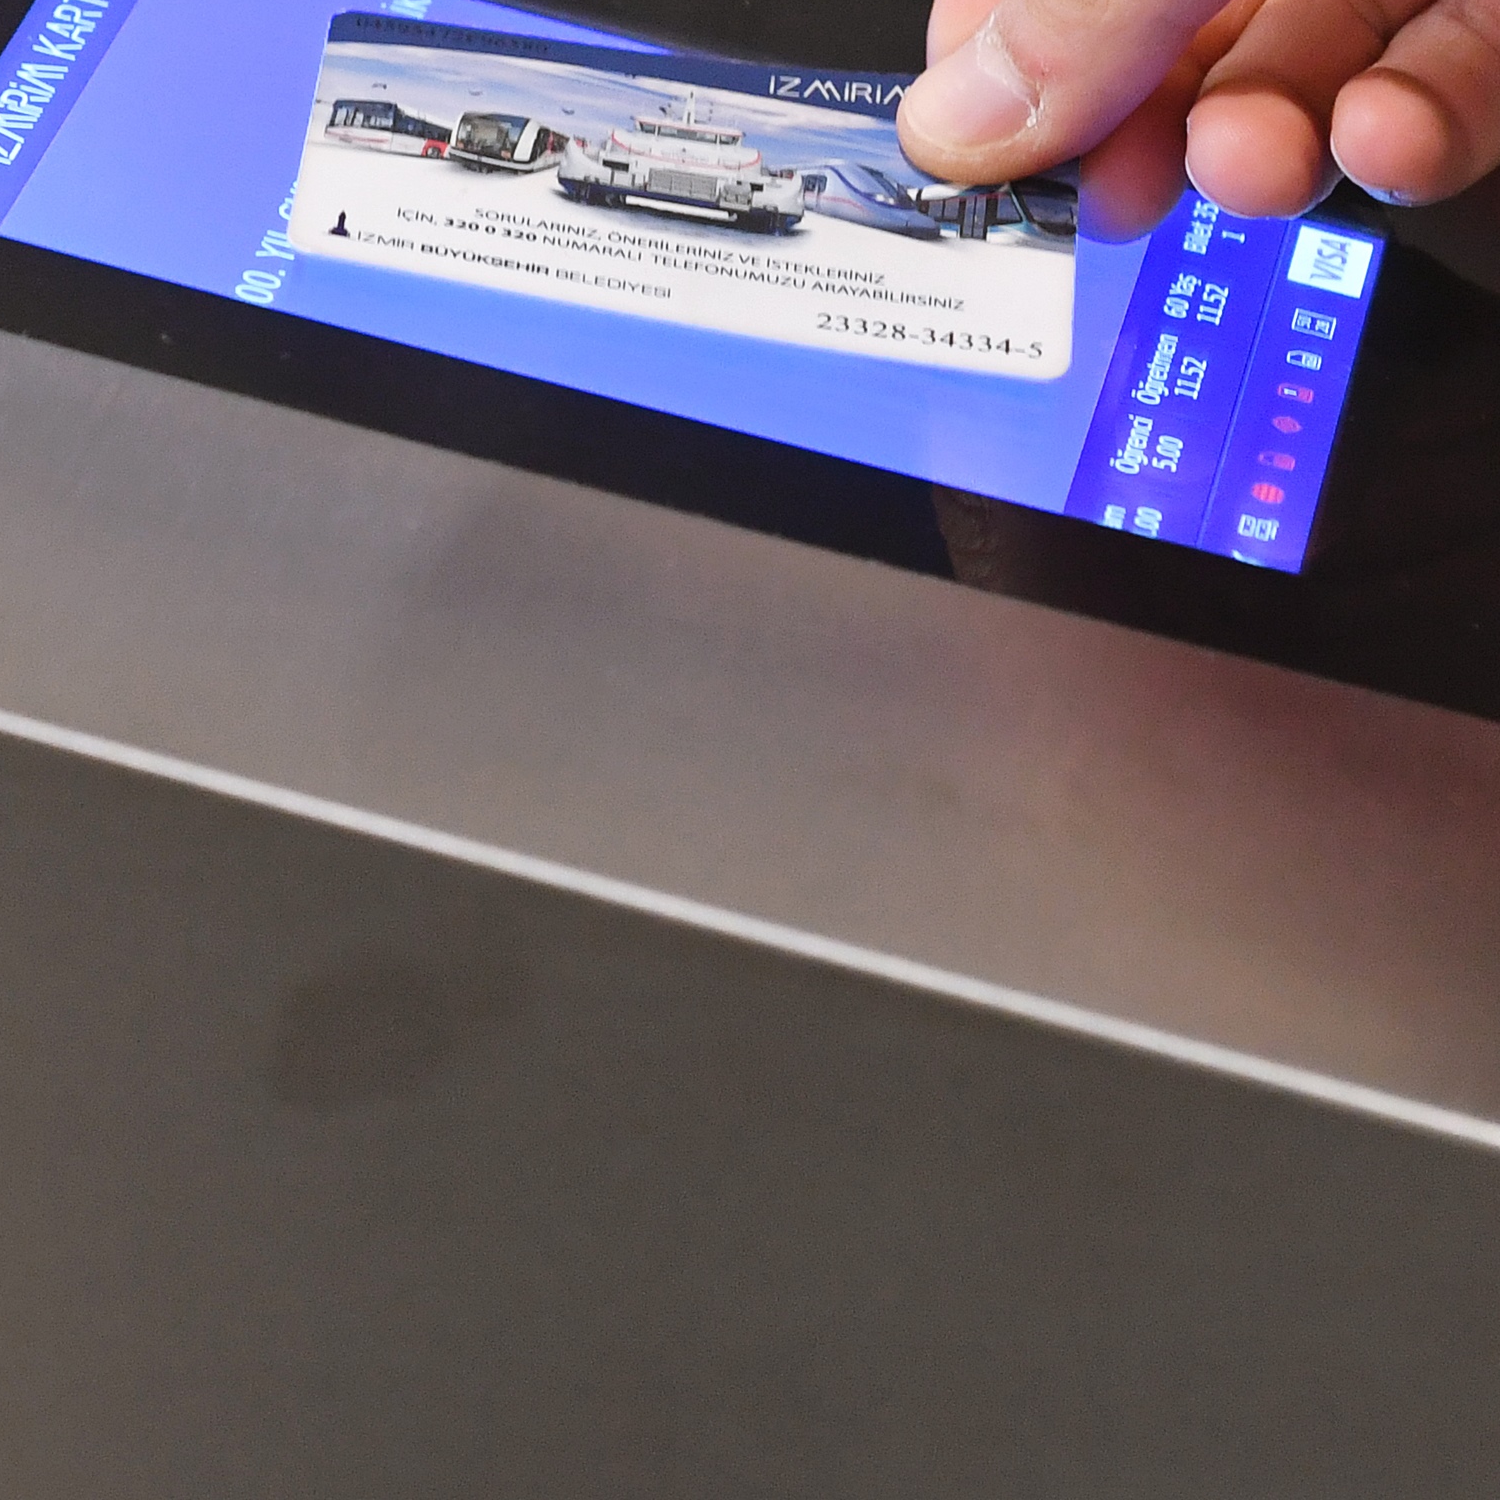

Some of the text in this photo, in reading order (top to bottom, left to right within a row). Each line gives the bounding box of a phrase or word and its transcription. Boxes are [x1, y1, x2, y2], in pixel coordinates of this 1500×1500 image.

[420, 243, 550, 277] BÜYÜKŞEHİR
[485, 224, 496, 236] 0
[543, 235, 642, 261] NUMARALI
[652, 252, 806, 290] TELEFONUMUZU
[811, 280, 965, 311] ARAYABİLİRSİNİZ
[607, 231, 734, 261] ÖNERİLERİNİZ
[739, 252, 761, 267] VE
[766, 256, 886, 285] İSTEKLERİNİZ
[1309, 238, 1352, 281] VISA
[1163, 273, 1202, 319] 60 Yaş
[816, 312, 1044, 360] 23328-34334-5
[1109, 414, 1154, 475] Öğrenci
[1151, 435, 1184, 474] 5.00
